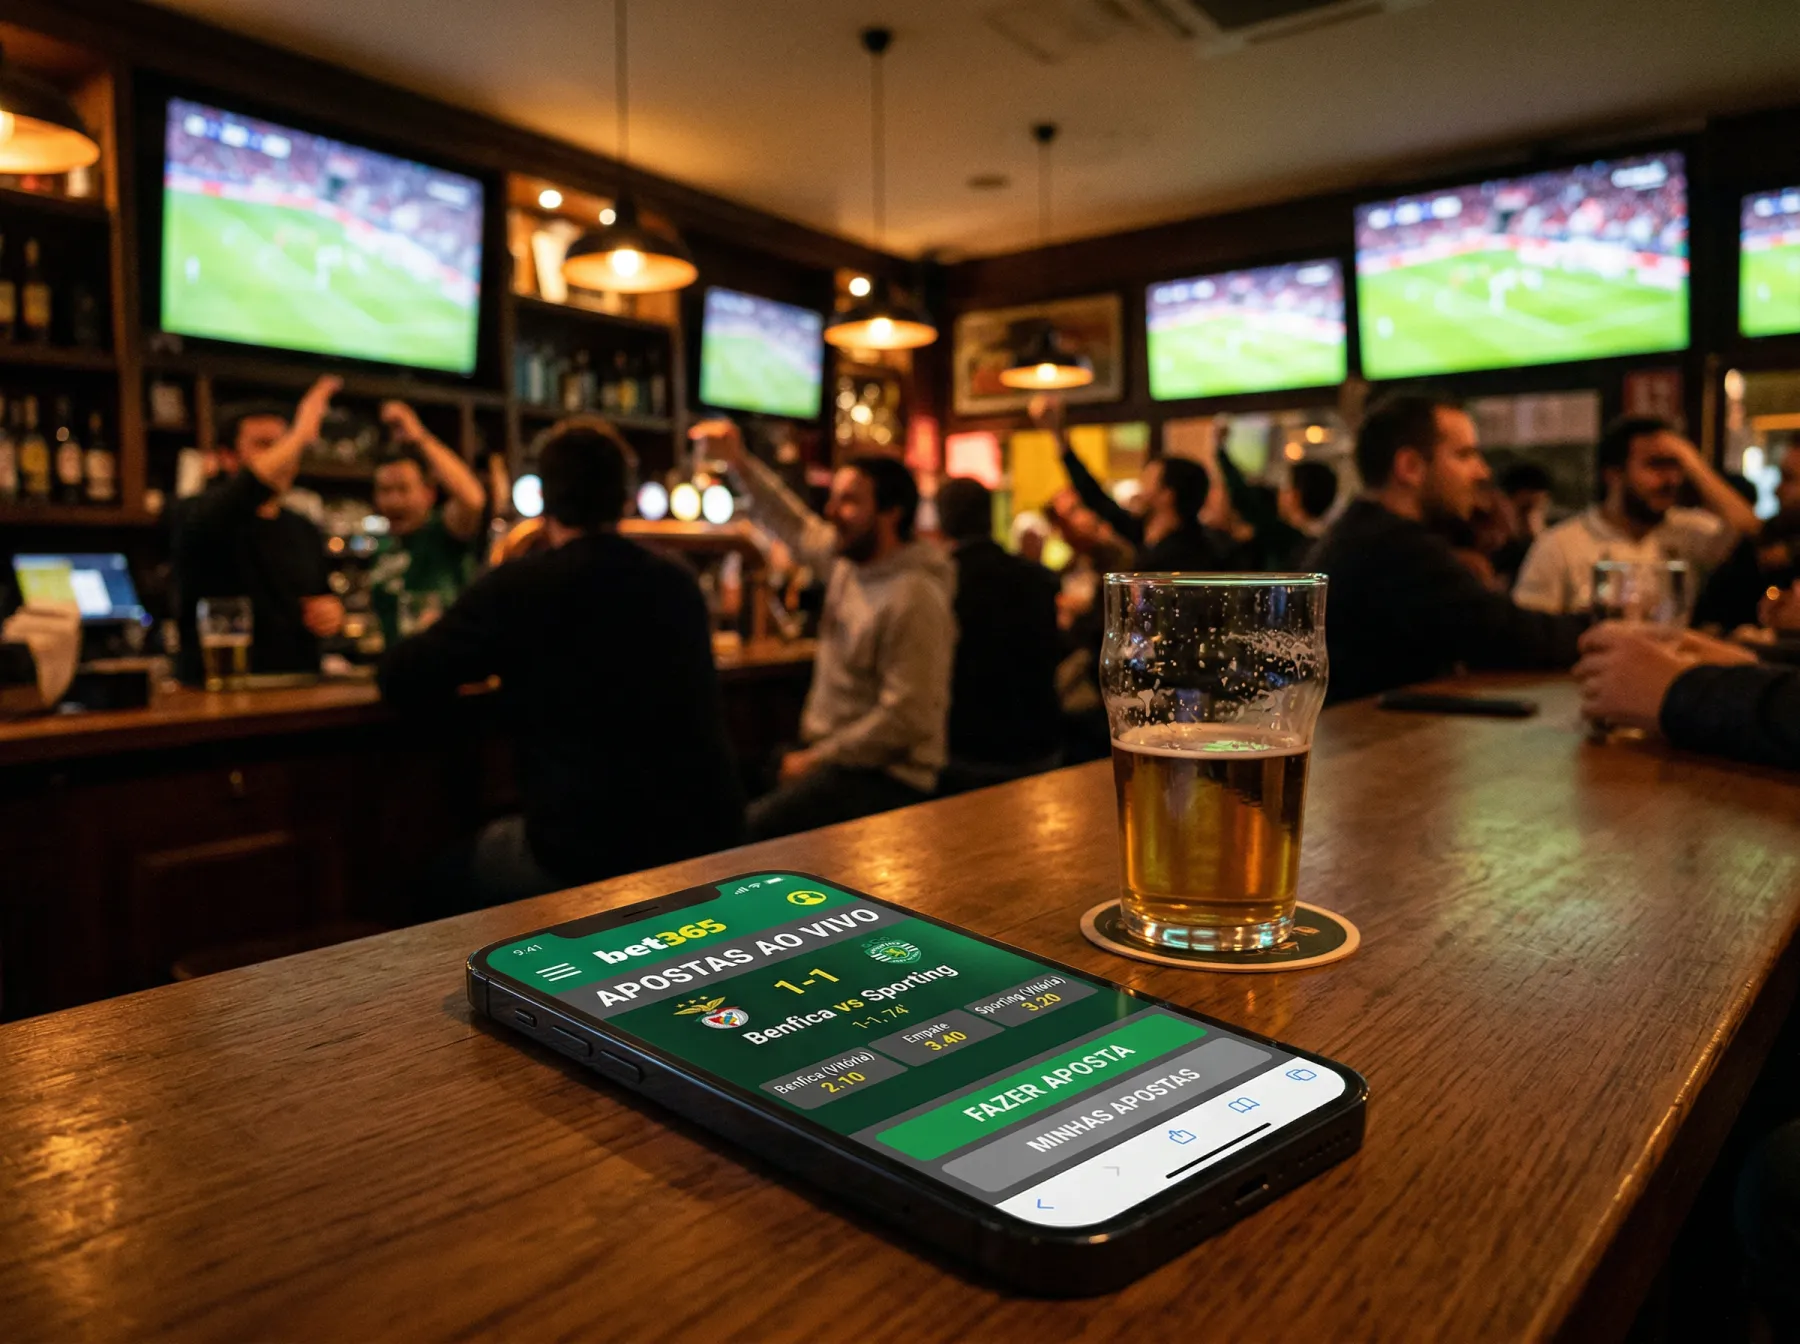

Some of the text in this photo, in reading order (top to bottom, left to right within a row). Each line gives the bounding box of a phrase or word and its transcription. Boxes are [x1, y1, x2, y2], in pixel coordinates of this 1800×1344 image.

[513, 943, 543, 956] 9:41
[592, 918, 727, 965] bet365
[596, 908, 880, 1008] APOSTAS AO VIVO
[773, 968, 840, 996] 1-1
[741, 964, 959, 1046] Benfica vs Sporting
[1021, 992, 1062, 1012] 3.20
[902, 1021, 951, 1044] Empate
[924, 1030, 967, 1052] 3.40
[773, 1070, 826, 1096] Benfica
[820, 1070, 866, 1094] 2.10
[963, 1044, 1137, 1123] FAZER APOSTA
[1026, 1067, 1202, 1154] MINHAS APOSTAS
